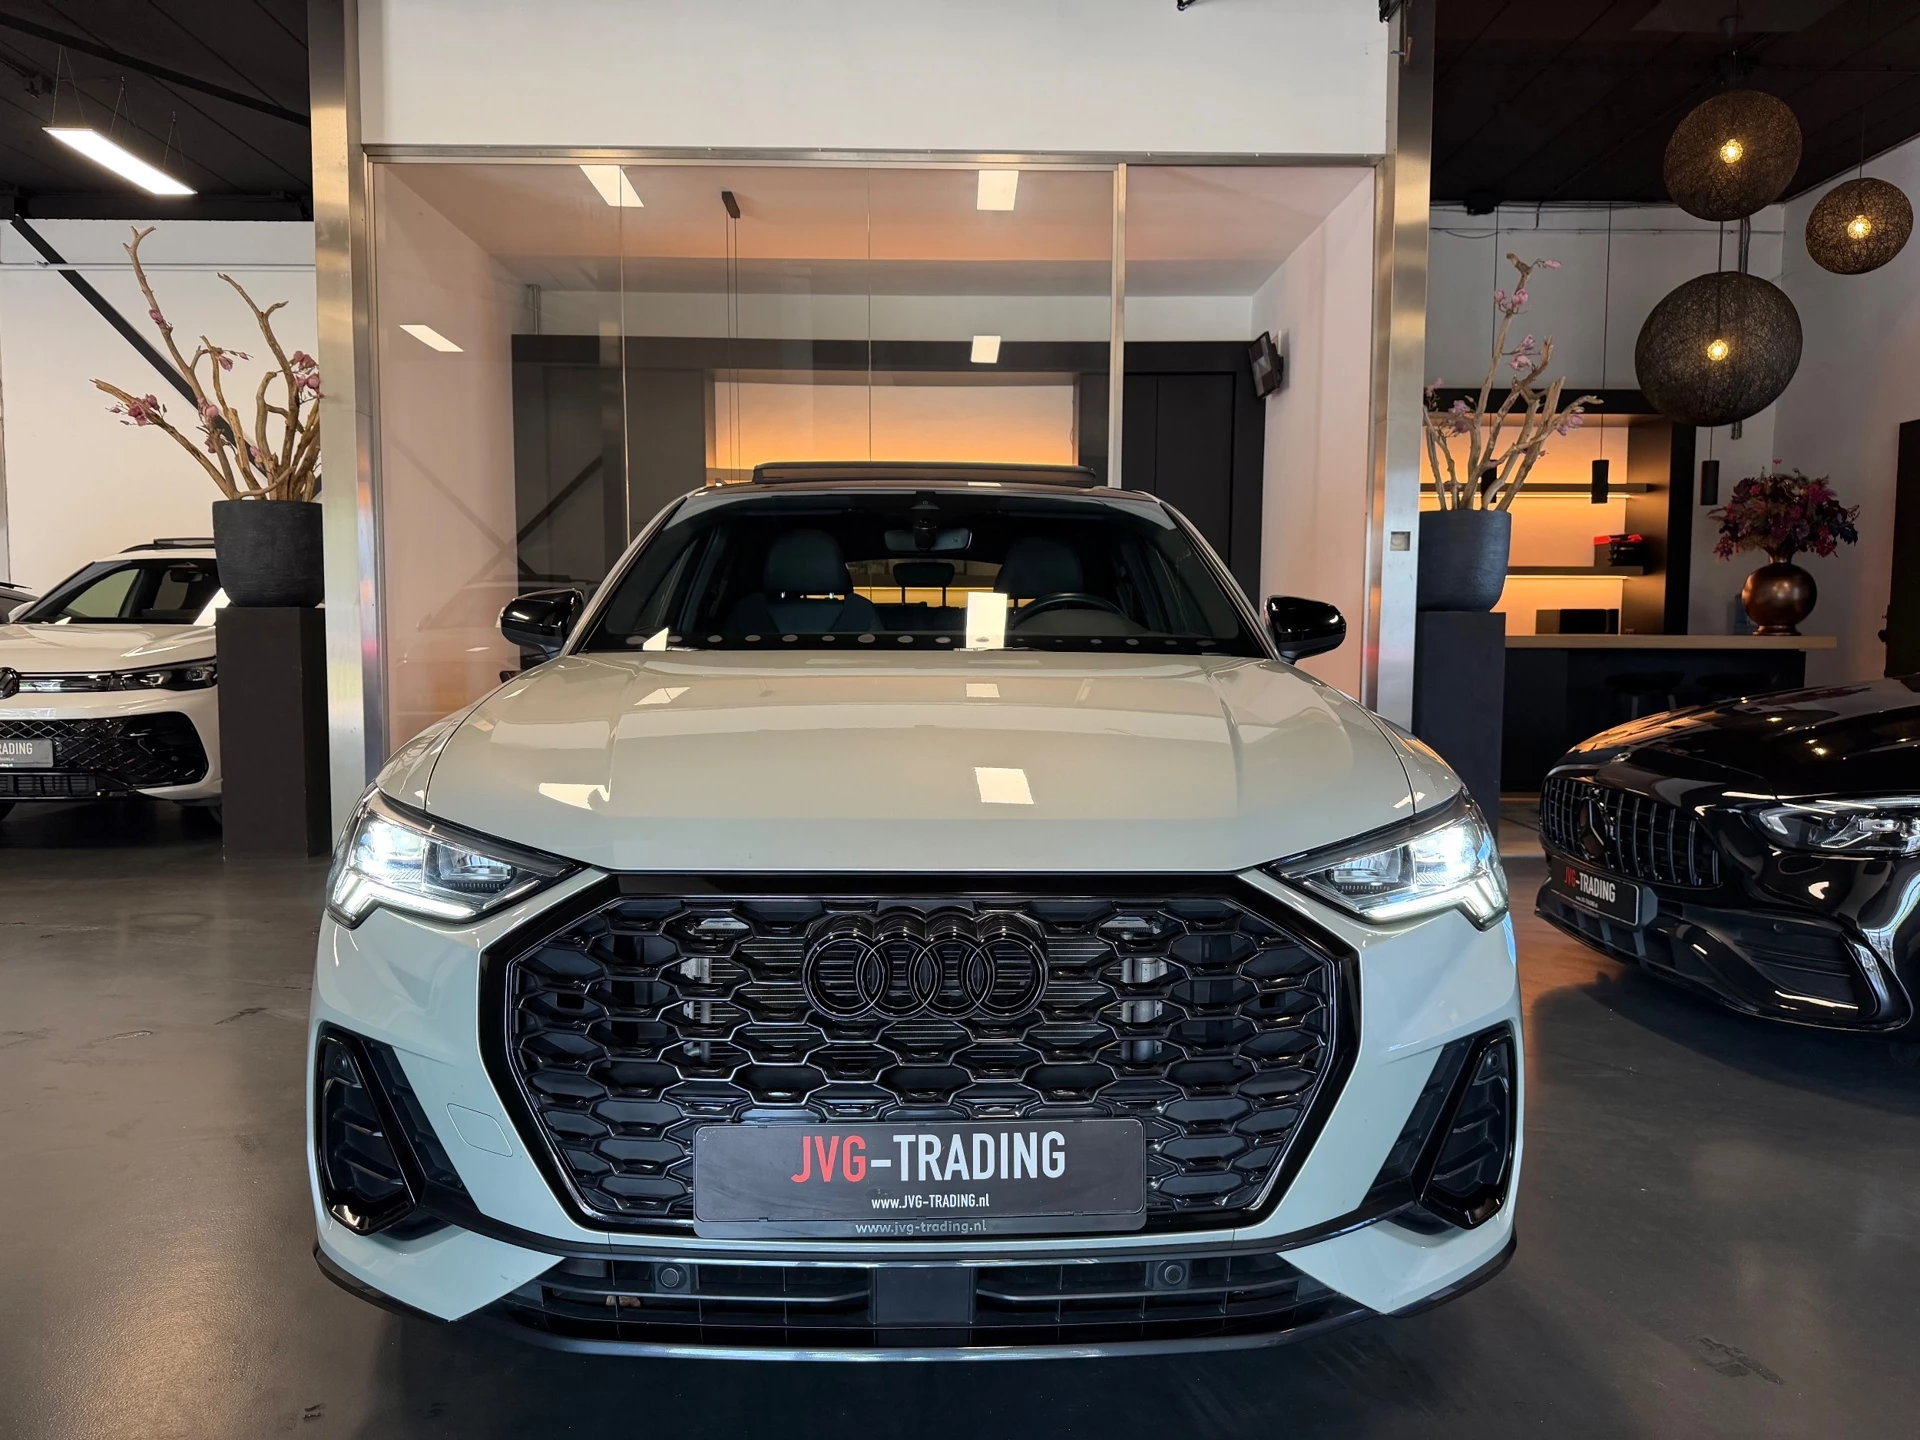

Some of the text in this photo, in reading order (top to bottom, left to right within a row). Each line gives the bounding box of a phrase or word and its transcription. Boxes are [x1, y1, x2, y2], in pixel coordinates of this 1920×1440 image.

[1564, 866, 1616, 903] JVG-TRADING
[790, 1130, 1066, 1183] JVG-TRADING
[871, 1193, 990, 1209] www.JVG-TRADING.nl
[855, 1219, 987, 1236] www.jvg-trading.nl
